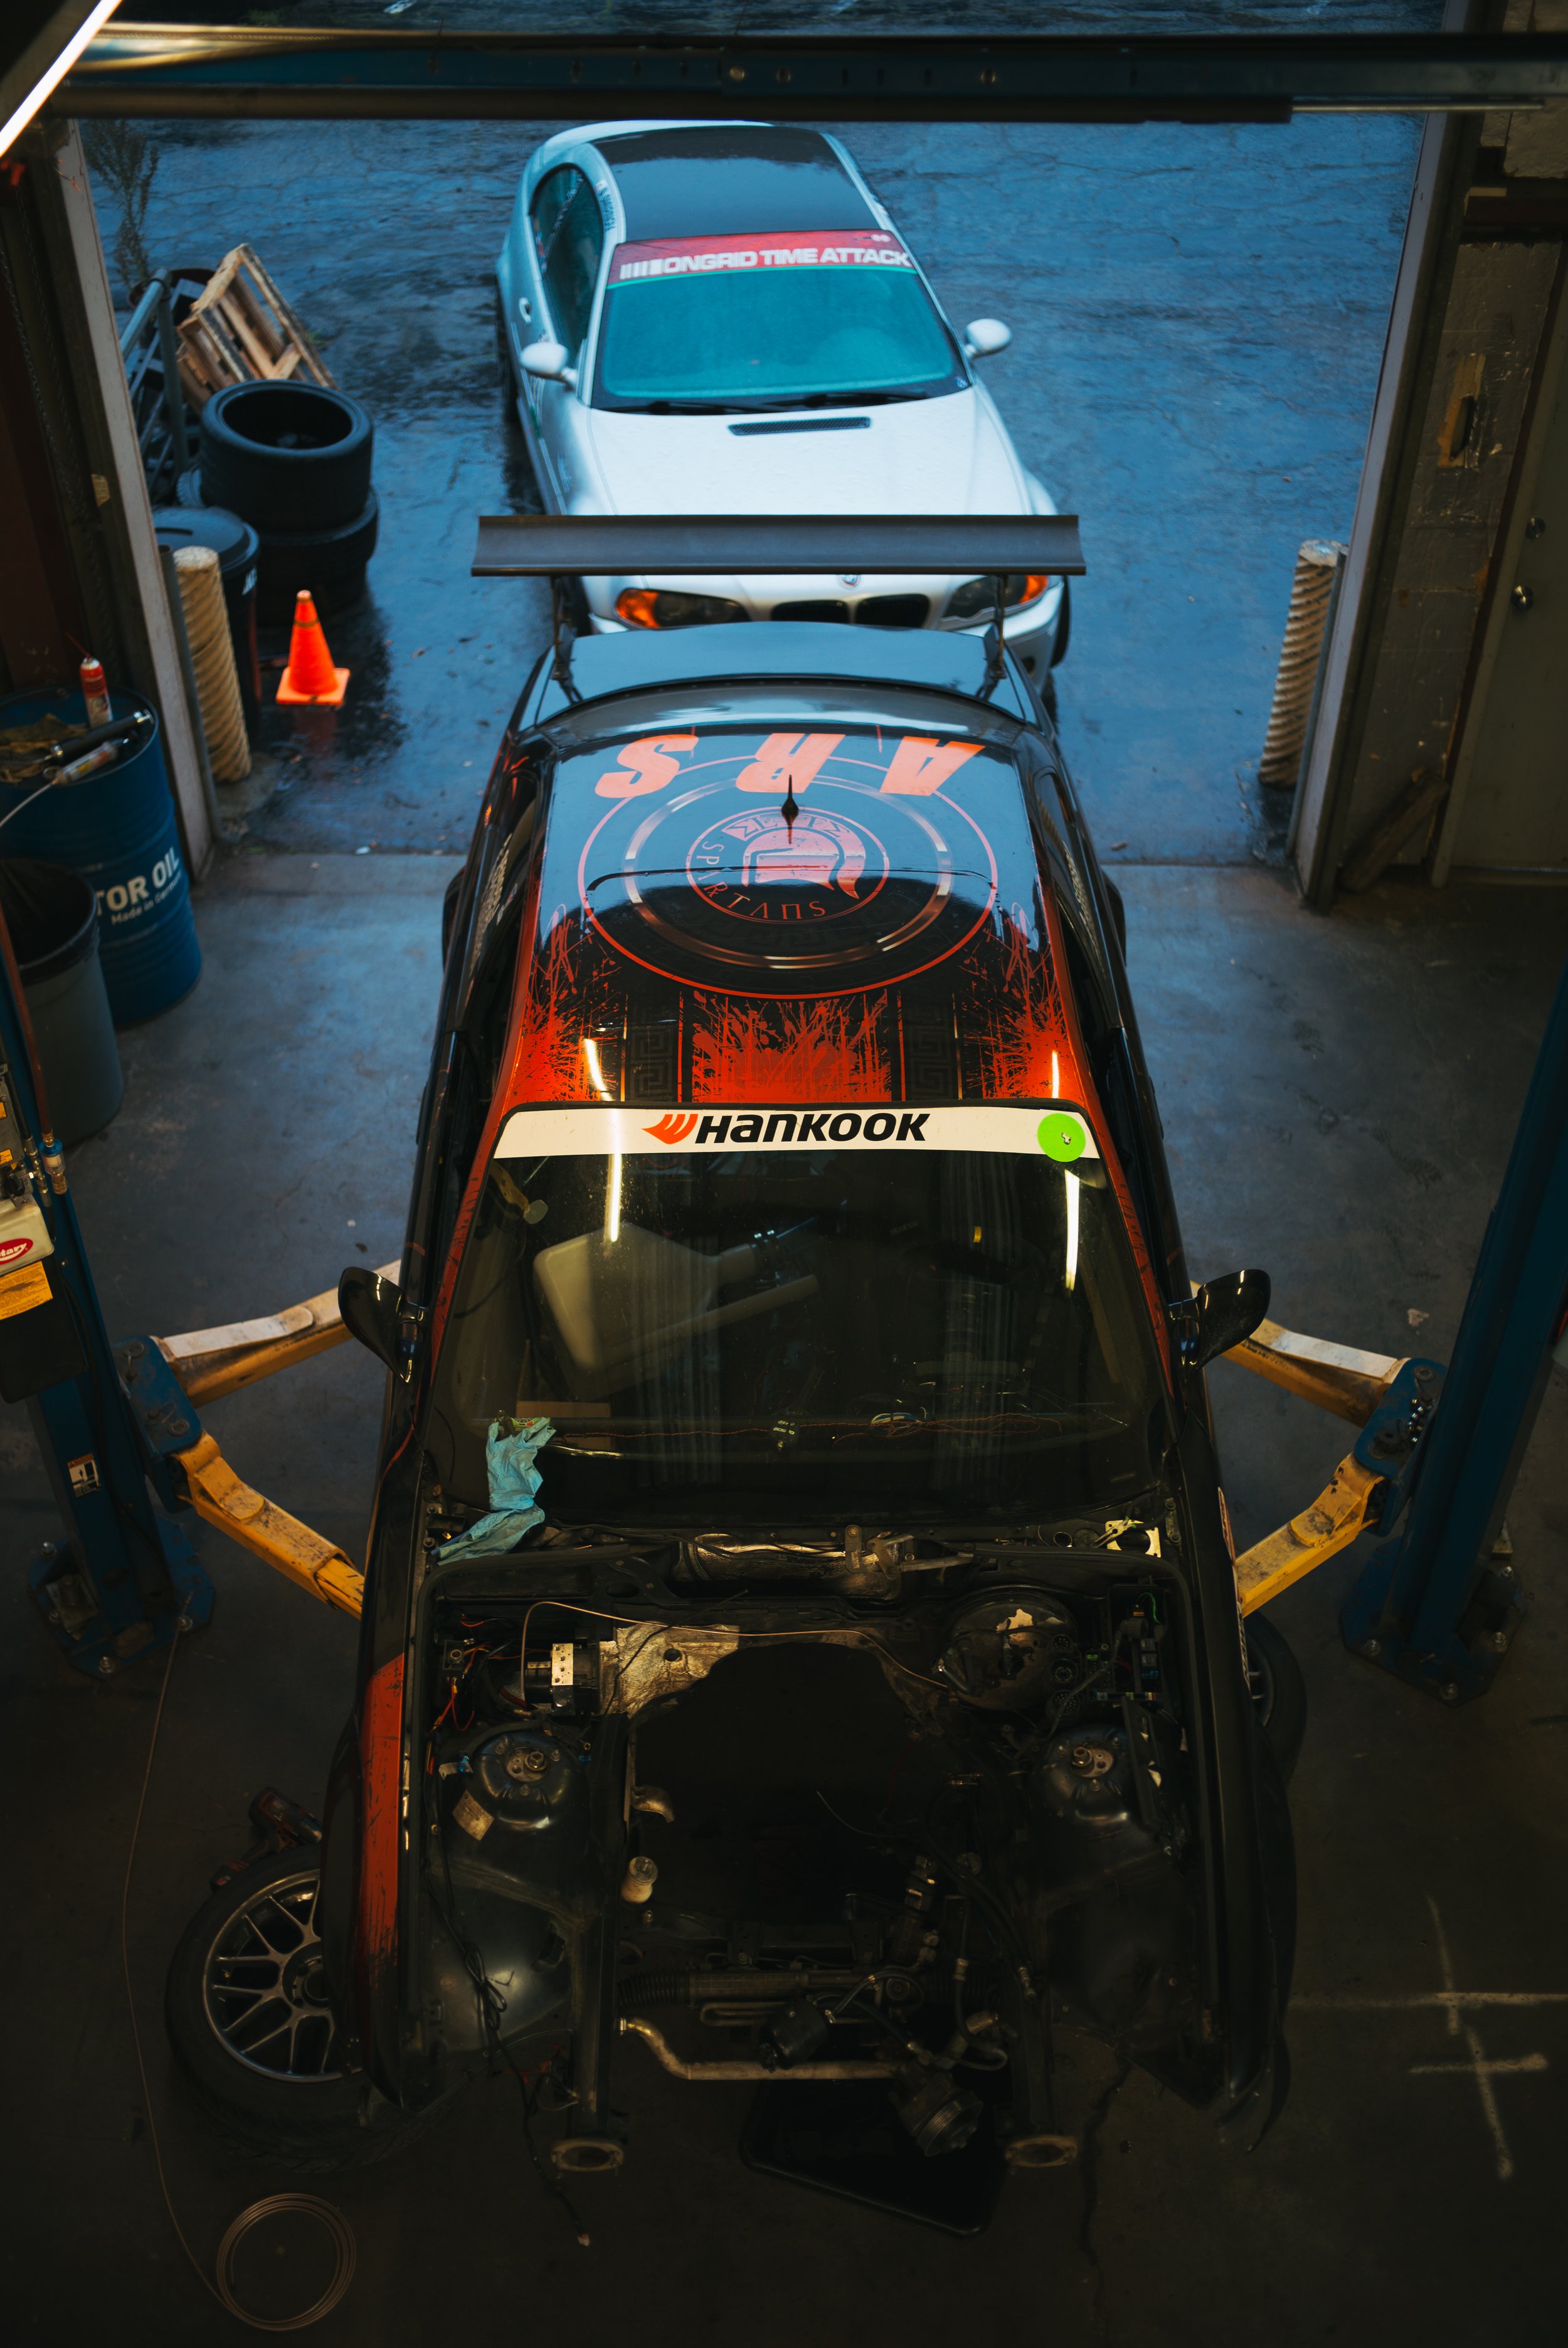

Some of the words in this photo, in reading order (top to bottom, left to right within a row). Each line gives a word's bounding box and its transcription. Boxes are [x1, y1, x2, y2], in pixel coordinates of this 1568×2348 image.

[662, 251, 757, 274] ONGRID
[759, 248, 818, 265] TIME
[819, 247, 913, 267] ATTACK
[152, 845, 179, 889] OIL
[110, 906, 143, 925] Made
[144, 899, 154, 912] in
[0, 1242, 27, 1258] tary
